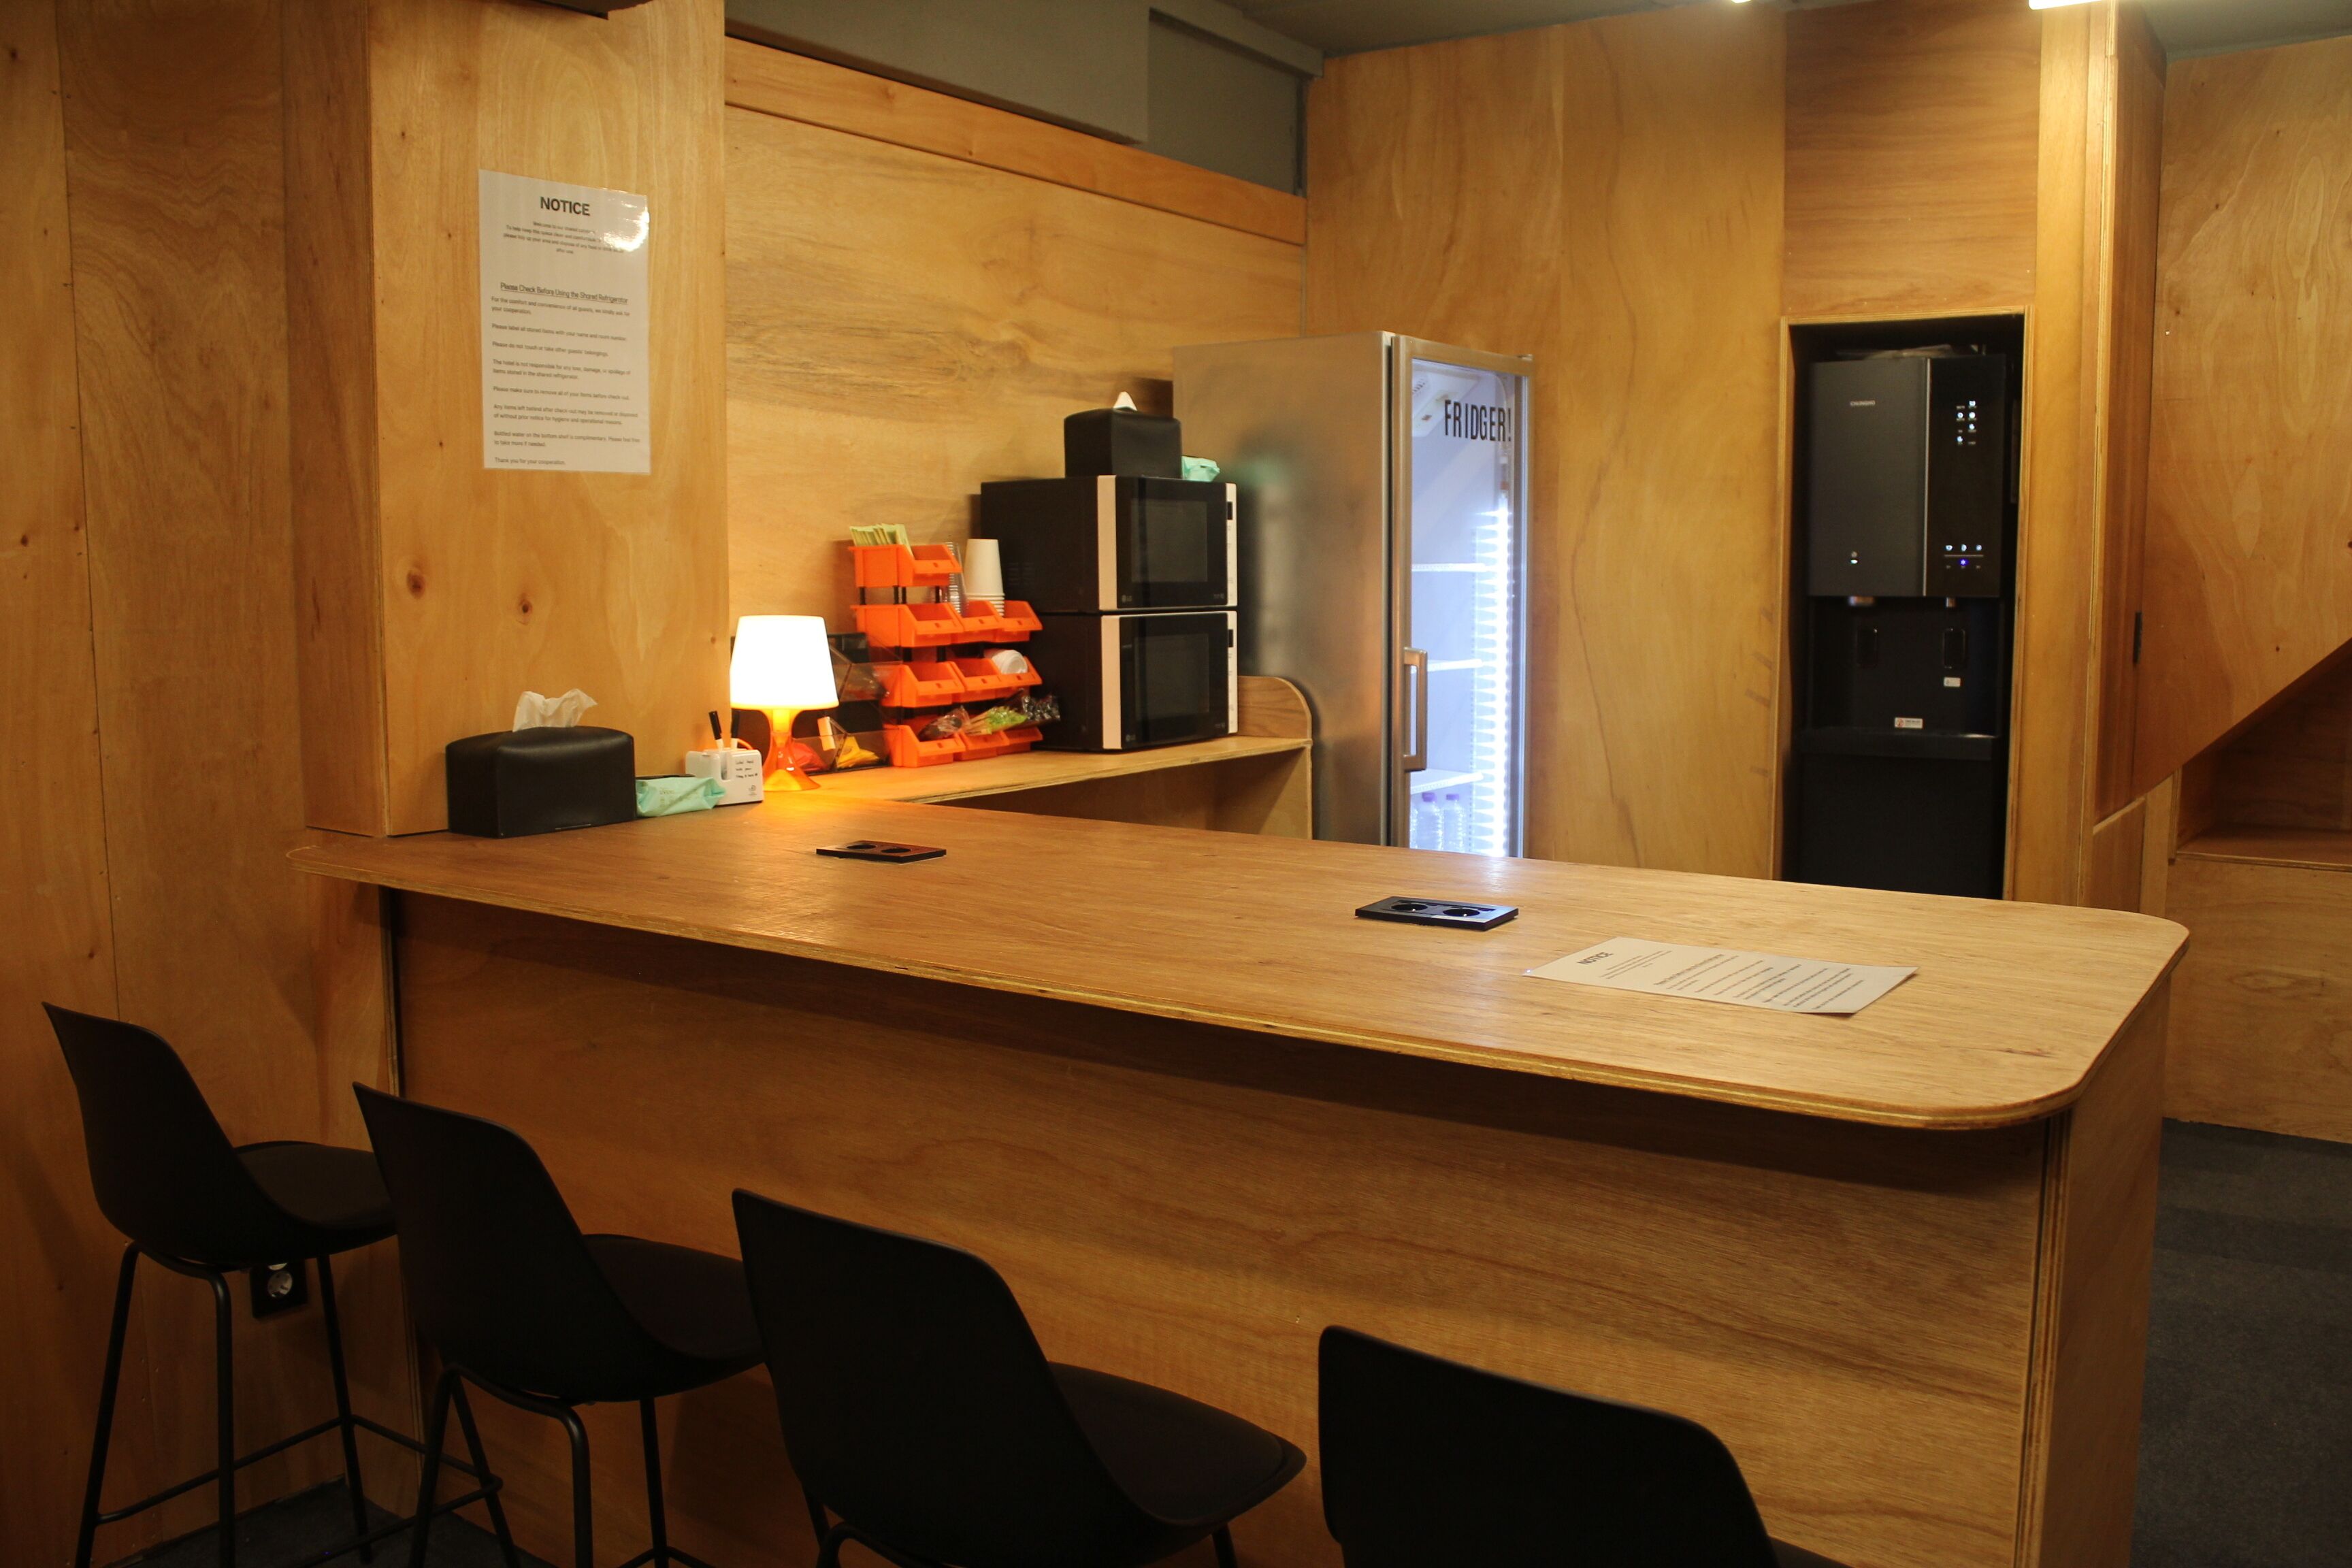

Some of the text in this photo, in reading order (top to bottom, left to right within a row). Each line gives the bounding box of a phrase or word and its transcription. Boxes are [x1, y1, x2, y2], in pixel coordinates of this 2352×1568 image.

[540, 196, 591, 216] NOTICE
[500, 282, 518, 291] Please
[519, 284, 536, 293] Check
[536, 287, 555, 295] Before
[555, 289, 570, 298] Using
[580, 293, 598, 301] Shared
[598, 294, 628, 304] Refrigerator
[1444, 399, 1512, 442] FRIDGER!
[1576, 951, 1614, 965] NOTICE
